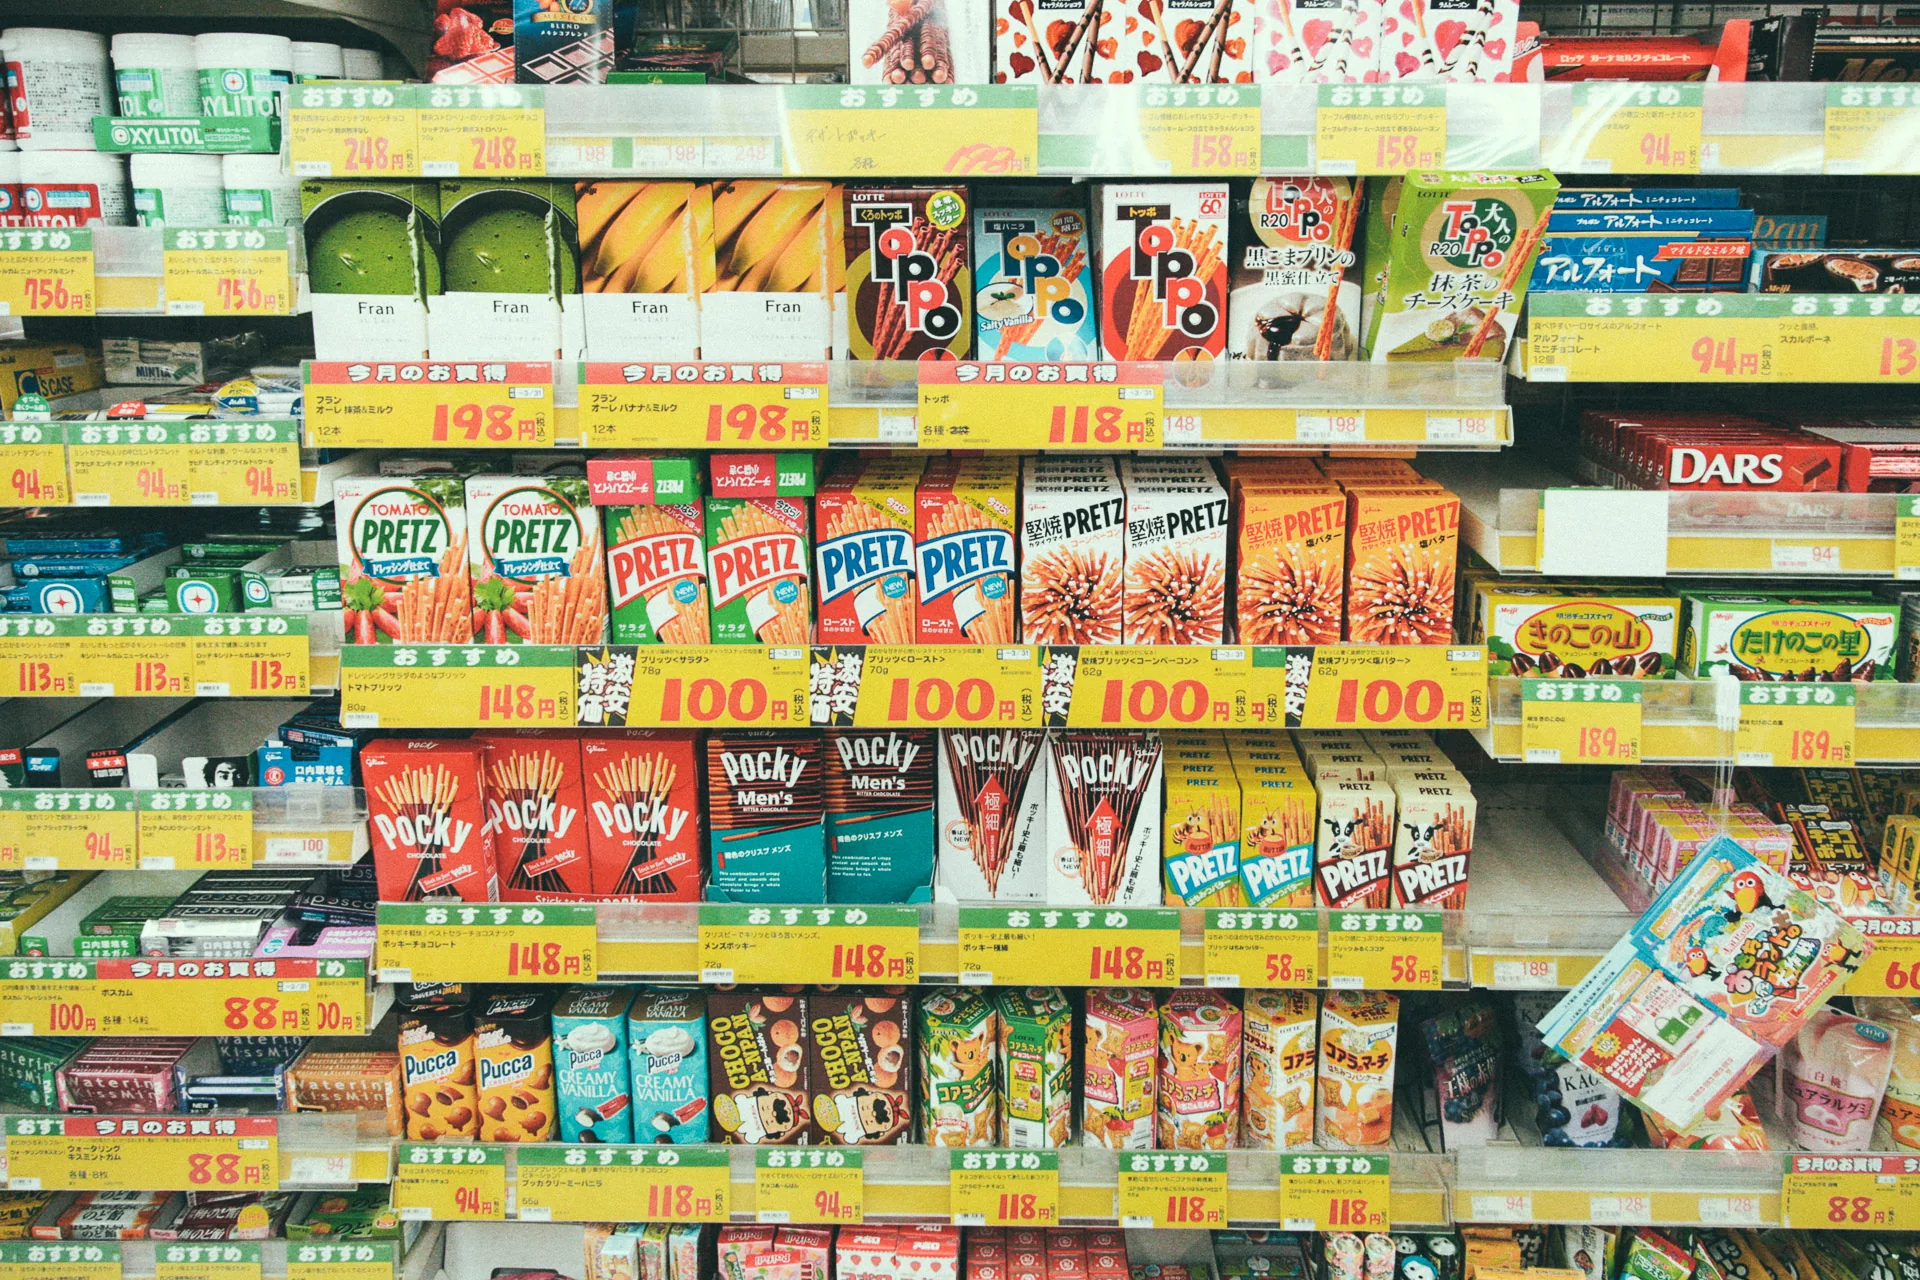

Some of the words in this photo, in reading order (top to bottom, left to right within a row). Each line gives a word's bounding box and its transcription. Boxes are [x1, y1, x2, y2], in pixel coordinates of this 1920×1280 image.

[1560, 55, 1584, 65] ロッテ
[1590, 54, 1692, 65] ガーナミルクチョコレート
[303, 88, 394, 107] おすすめ
[840, 88, 978, 107] おすすめ
[1146, 87, 1239, 106] おすすめ
[1331, 86, 1424, 106] おすすめ
[129, 124, 203, 146] XYLITOL
[860, 210, 903, 221] くろのトッポ
[1129, 207, 1157, 218] トッポ
[993, 222, 1026, 230] 塩バニラ
[1261, 214, 1288, 228] R20
[1604, 215, 1662, 228] アルフォート
[176, 231, 266, 249] おすすめ
[1430, 242, 1462, 256] R20
[1669, 244, 1746, 256] マイルドなミルク味
[1246, 248, 1354, 267] 黒ごまプリンの
[1540, 256, 1661, 285] アルフォート
[358, 302, 394, 315] Fran
[766, 300, 801, 312] Fran
[1405, 292, 1514, 310] チーズケーキ
[1586, 297, 1722, 316] おすすめ
[980, 321, 1002, 331] Salty
[1004, 314, 1033, 327] Vanilla
[1534, 334, 1585, 343] アルフォート
[1534, 345, 1600, 354] ミニチョコレート
[136, 366, 170, 378] MINTIA
[348, 364, 508, 383] 今月のお買得
[956, 364, 1118, 383] 今月のお買得
[316, 396, 341, 404] フラン
[592, 394, 617, 402] フラン
[923, 395, 950, 404] トッポ
[316, 406, 342, 414] オーレ
[592, 404, 618, 412] オーレ
[81, 425, 167, 442] おすすめ
[318, 426, 341, 435] 12本
[593, 424, 616, 434] 12本
[1669, 448, 1783, 484] DARS
[371, 504, 430, 516] TOMATO
[1026, 515, 1062, 542] 堅焼
[1063, 498, 1124, 538] PRETZ
[362, 519, 440, 553] PRETZ
[714, 538, 799, 598] PRETZ
[676, 586, 694, 596] NEW
[984, 581, 1002, 592] NEW
[87, 617, 171, 635] おすすめ
[204, 617, 288, 635] おすすめ
[1529, 619, 1642, 650] きのこの山
[1739, 629, 1861, 656] たけのこの里
[393, 649, 520, 666] おすすめ
[642, 666, 660, 675] 78g
[870, 665, 889, 675] 70g
[1082, 667, 1102, 676] 62g
[1318, 667, 1338, 676] 62g
[348, 684, 402, 692] トマトプリッツ
[1536, 682, 1622, 701] おすすめ
[1749, 686, 1835, 705] おすすめ
[347, 703, 366, 712] 80g
[1187, 779, 1218, 787] PRETZ
[1339, 782, 1371, 791] PRETZ
[35, 793, 116, 810] おすすめ
[738, 791, 793, 806] Men's
[985, 792, 1000, 830] 極細
[1808, 830, 1858, 842] チョコ
[302, 839, 323, 851] 100
[1815, 844, 1863, 859] ボール
[1170, 845, 1237, 895] PRETZ
[1321, 852, 1388, 899] PRETZ
[426, 908, 544, 924] おすすめ
[749, 908, 868, 925] おすすめ
[1007, 911, 1128, 927] おすすめ
[1341, 915, 1422, 931] おすすめ
[383, 940, 456, 948] ポッキーチョコレート
[704, 942, 756, 950] メンズポッキー
[964, 944, 1008, 952] ポッキー極細
[131, 961, 277, 977] 今月のお買得
[383, 959, 400, 968] 72g
[101, 988, 133, 997] ポスカム
[712, 1017, 750, 1089] CHOCO
[406, 1050, 459, 1085] Pucca
[647, 1053, 681, 1073] Pucca
[559, 1071, 616, 1084] CREAMY
[560, 1084, 618, 1096] VANILLA
[96, 1120, 236, 1135] 今月のお買得
[768, 1150, 845, 1167] おすすめ
[1131, 1154, 1209, 1172] おすすめ
[1292, 1157, 1371, 1174] おすすめ
[1797, 1158, 1882, 1172] 今月のお買得
[1506, 1196, 1524, 1211] 94
[28, 1246, 103, 1262] おすすめ
